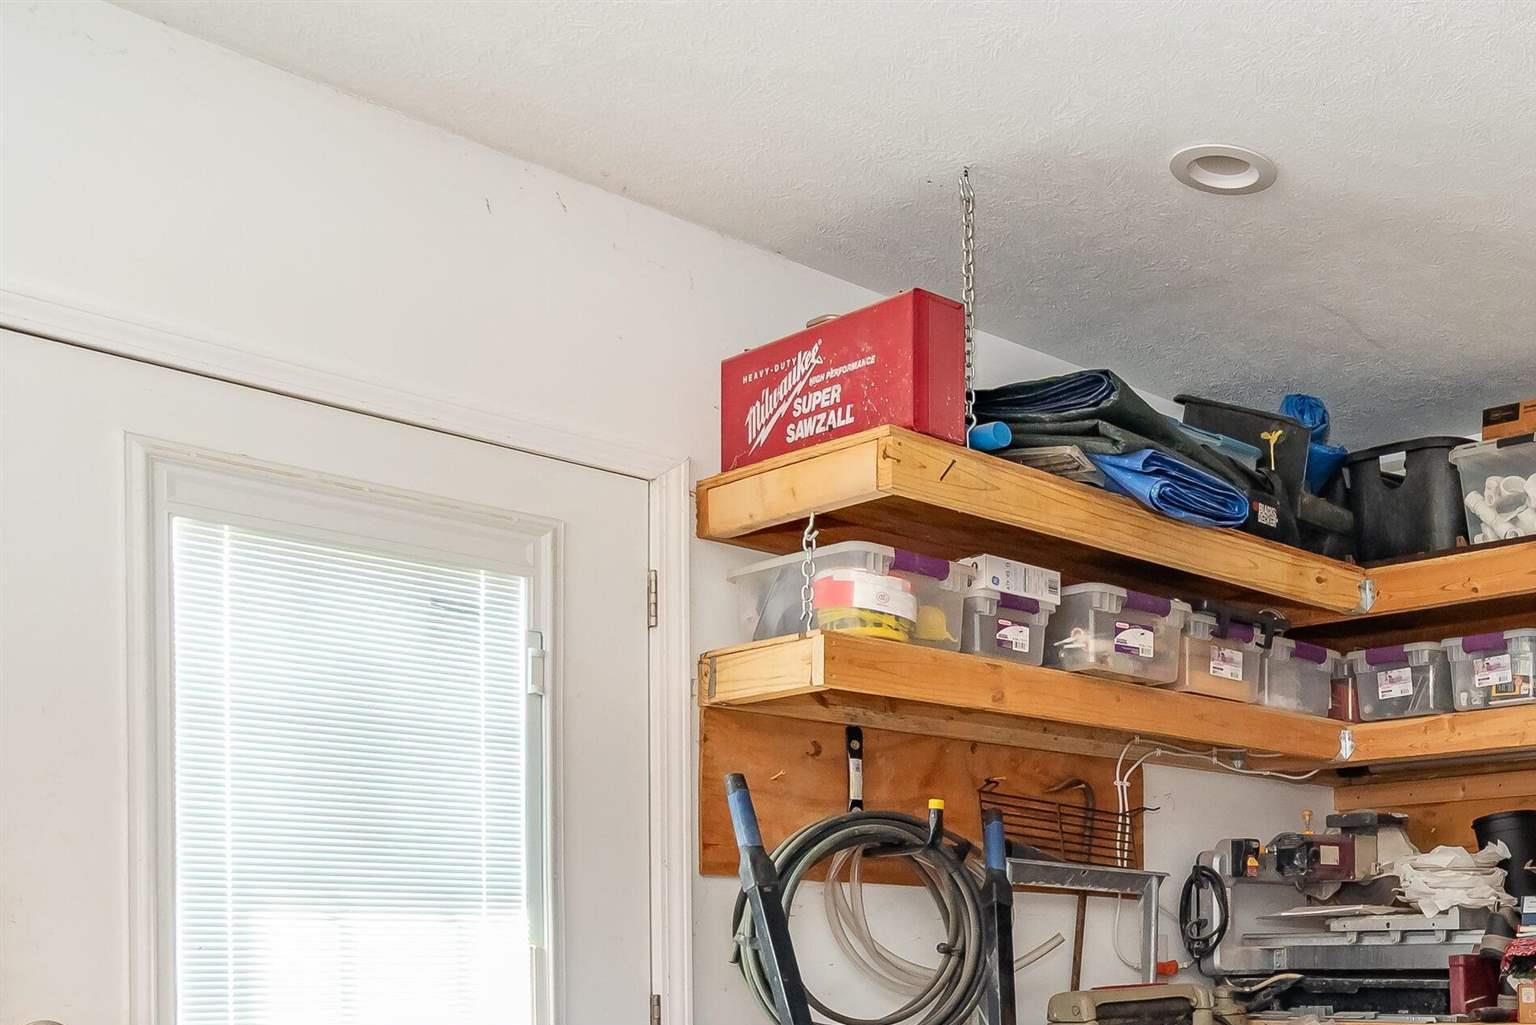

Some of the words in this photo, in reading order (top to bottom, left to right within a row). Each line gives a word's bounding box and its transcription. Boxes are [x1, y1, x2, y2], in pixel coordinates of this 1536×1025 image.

[743, 357, 797, 384] HEAVY-DUTY
[826, 355, 876, 380] PERFORMANCE
[744, 342, 823, 450] Milwaukee
[793, 384, 841, 417] SUPER
[786, 404, 854, 443] SAWZALL
